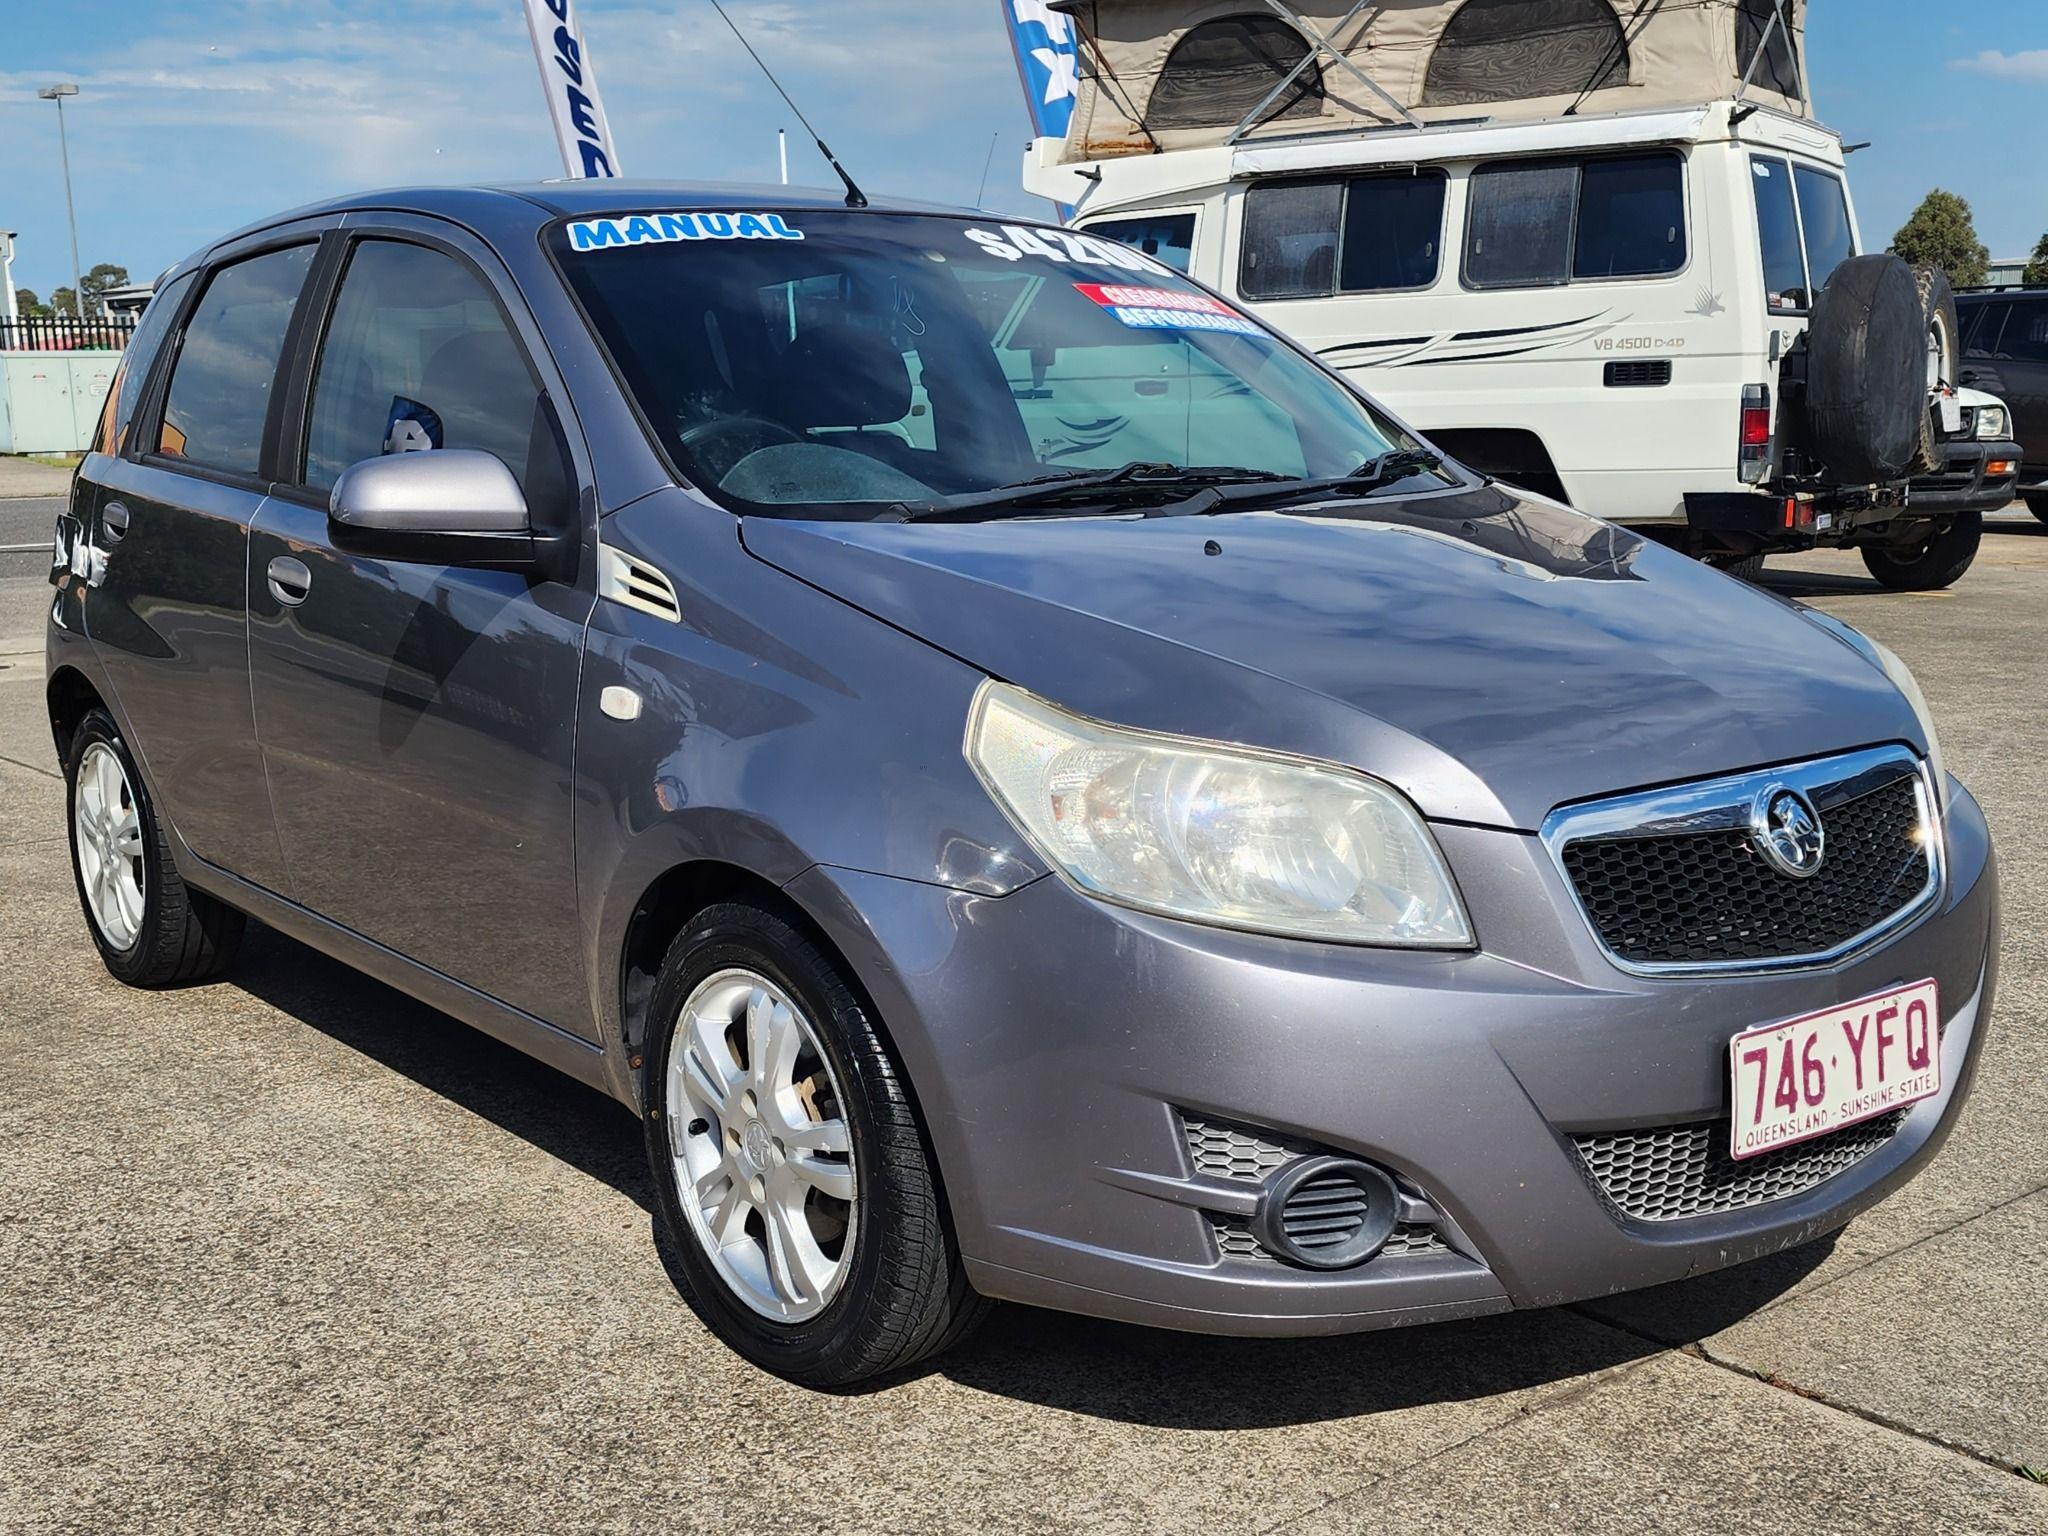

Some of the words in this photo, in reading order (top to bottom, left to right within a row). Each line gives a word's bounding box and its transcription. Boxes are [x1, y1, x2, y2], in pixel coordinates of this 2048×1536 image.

[568, 213, 804, 250] MANUAL
[1100, 286, 1227, 316] CLEARANCE
[1594, 338, 1613, 350] V8
[1616, 337, 1652, 350] 4500
[1746, 1109, 1828, 1148] QUEENSLAND
[1841, 1086, 1894, 1119] SUNSHINE
[1900, 1074, 1931, 1098] STATE
